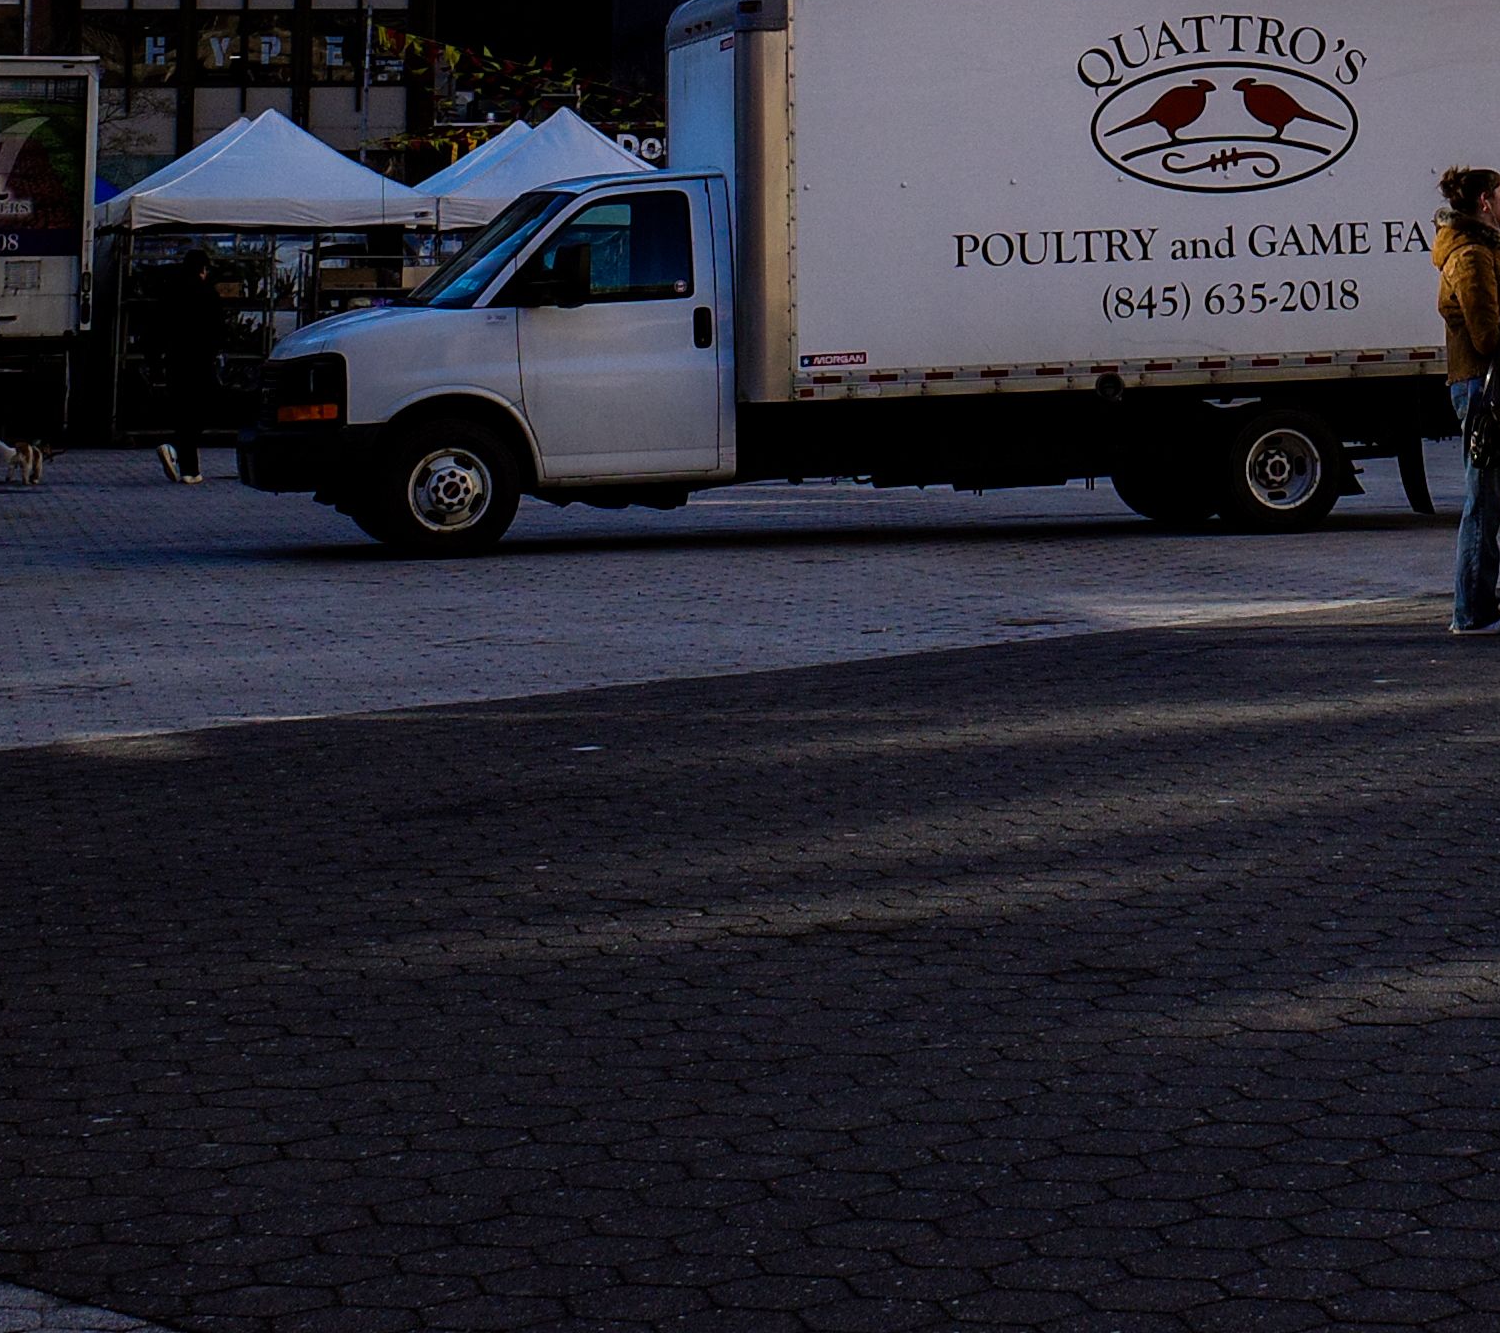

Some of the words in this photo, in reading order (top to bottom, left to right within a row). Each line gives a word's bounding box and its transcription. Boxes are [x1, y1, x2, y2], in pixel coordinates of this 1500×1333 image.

[1077, 15, 1367, 97] QUATTRO'S
[954, 227, 1159, 268] POULTRY
[1170, 225, 1236, 261] and
[1247, 220, 1371, 259] GAME
[1382, 219, 1433, 255] FA
[1102, 281, 1192, 324] (845)
[1203, 278, 1360, 316] 635-2018
[813, 354, 864, 365] MORGAN
